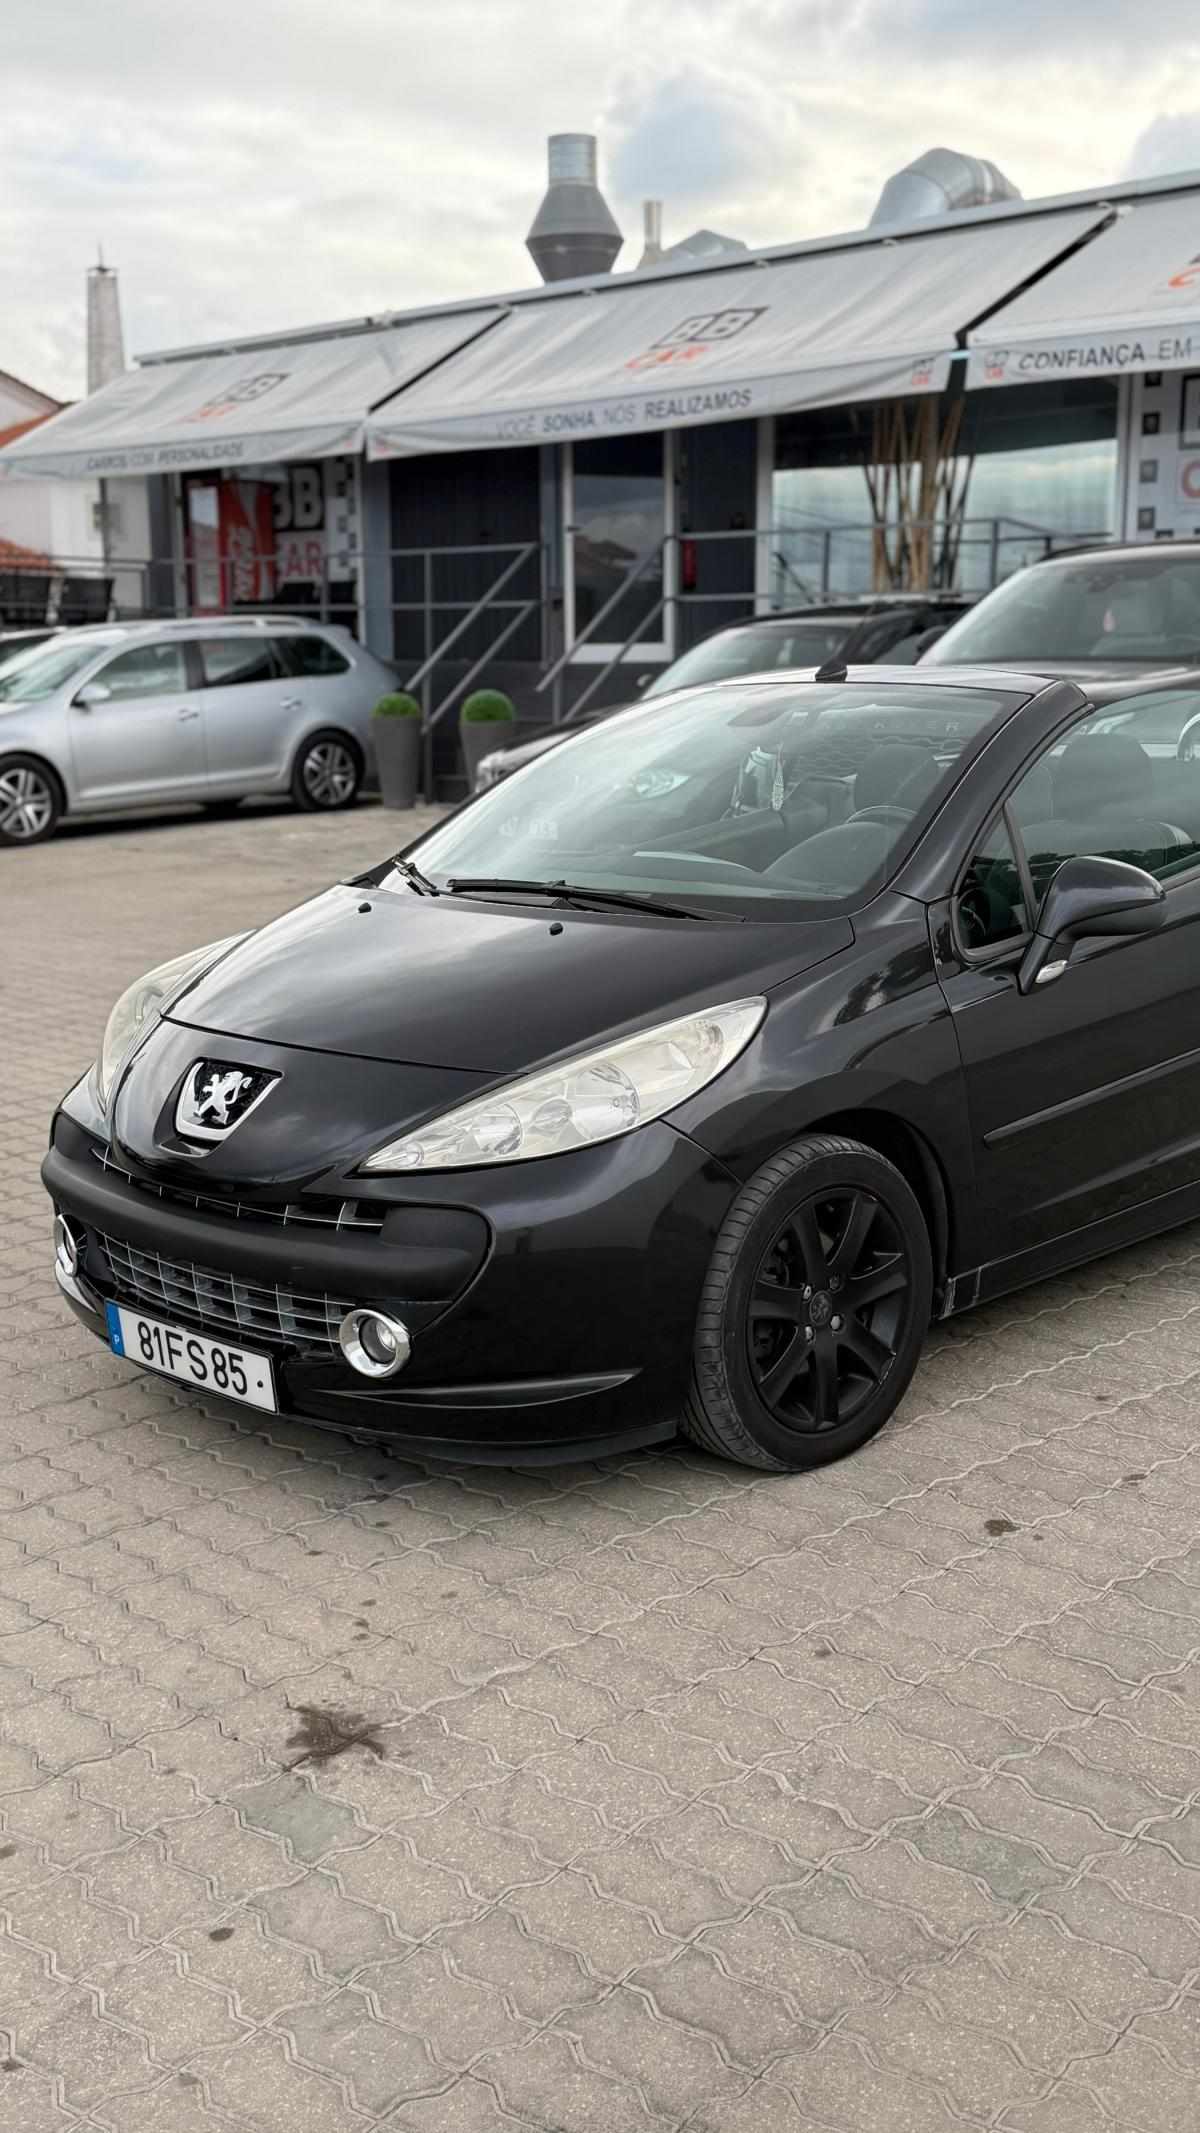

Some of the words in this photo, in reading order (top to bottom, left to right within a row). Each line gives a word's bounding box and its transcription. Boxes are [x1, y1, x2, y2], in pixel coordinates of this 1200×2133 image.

[1018, 343, 1146, 370] CONFIANÇA
[1158, 338, 1192, 361] EM
[543, 408, 595, 433] SONHA
[645, 389, 752, 421] REALIZAMOS
[286, 541, 321, 577] AR
[137, 1321, 247, 1395] 81FS85
